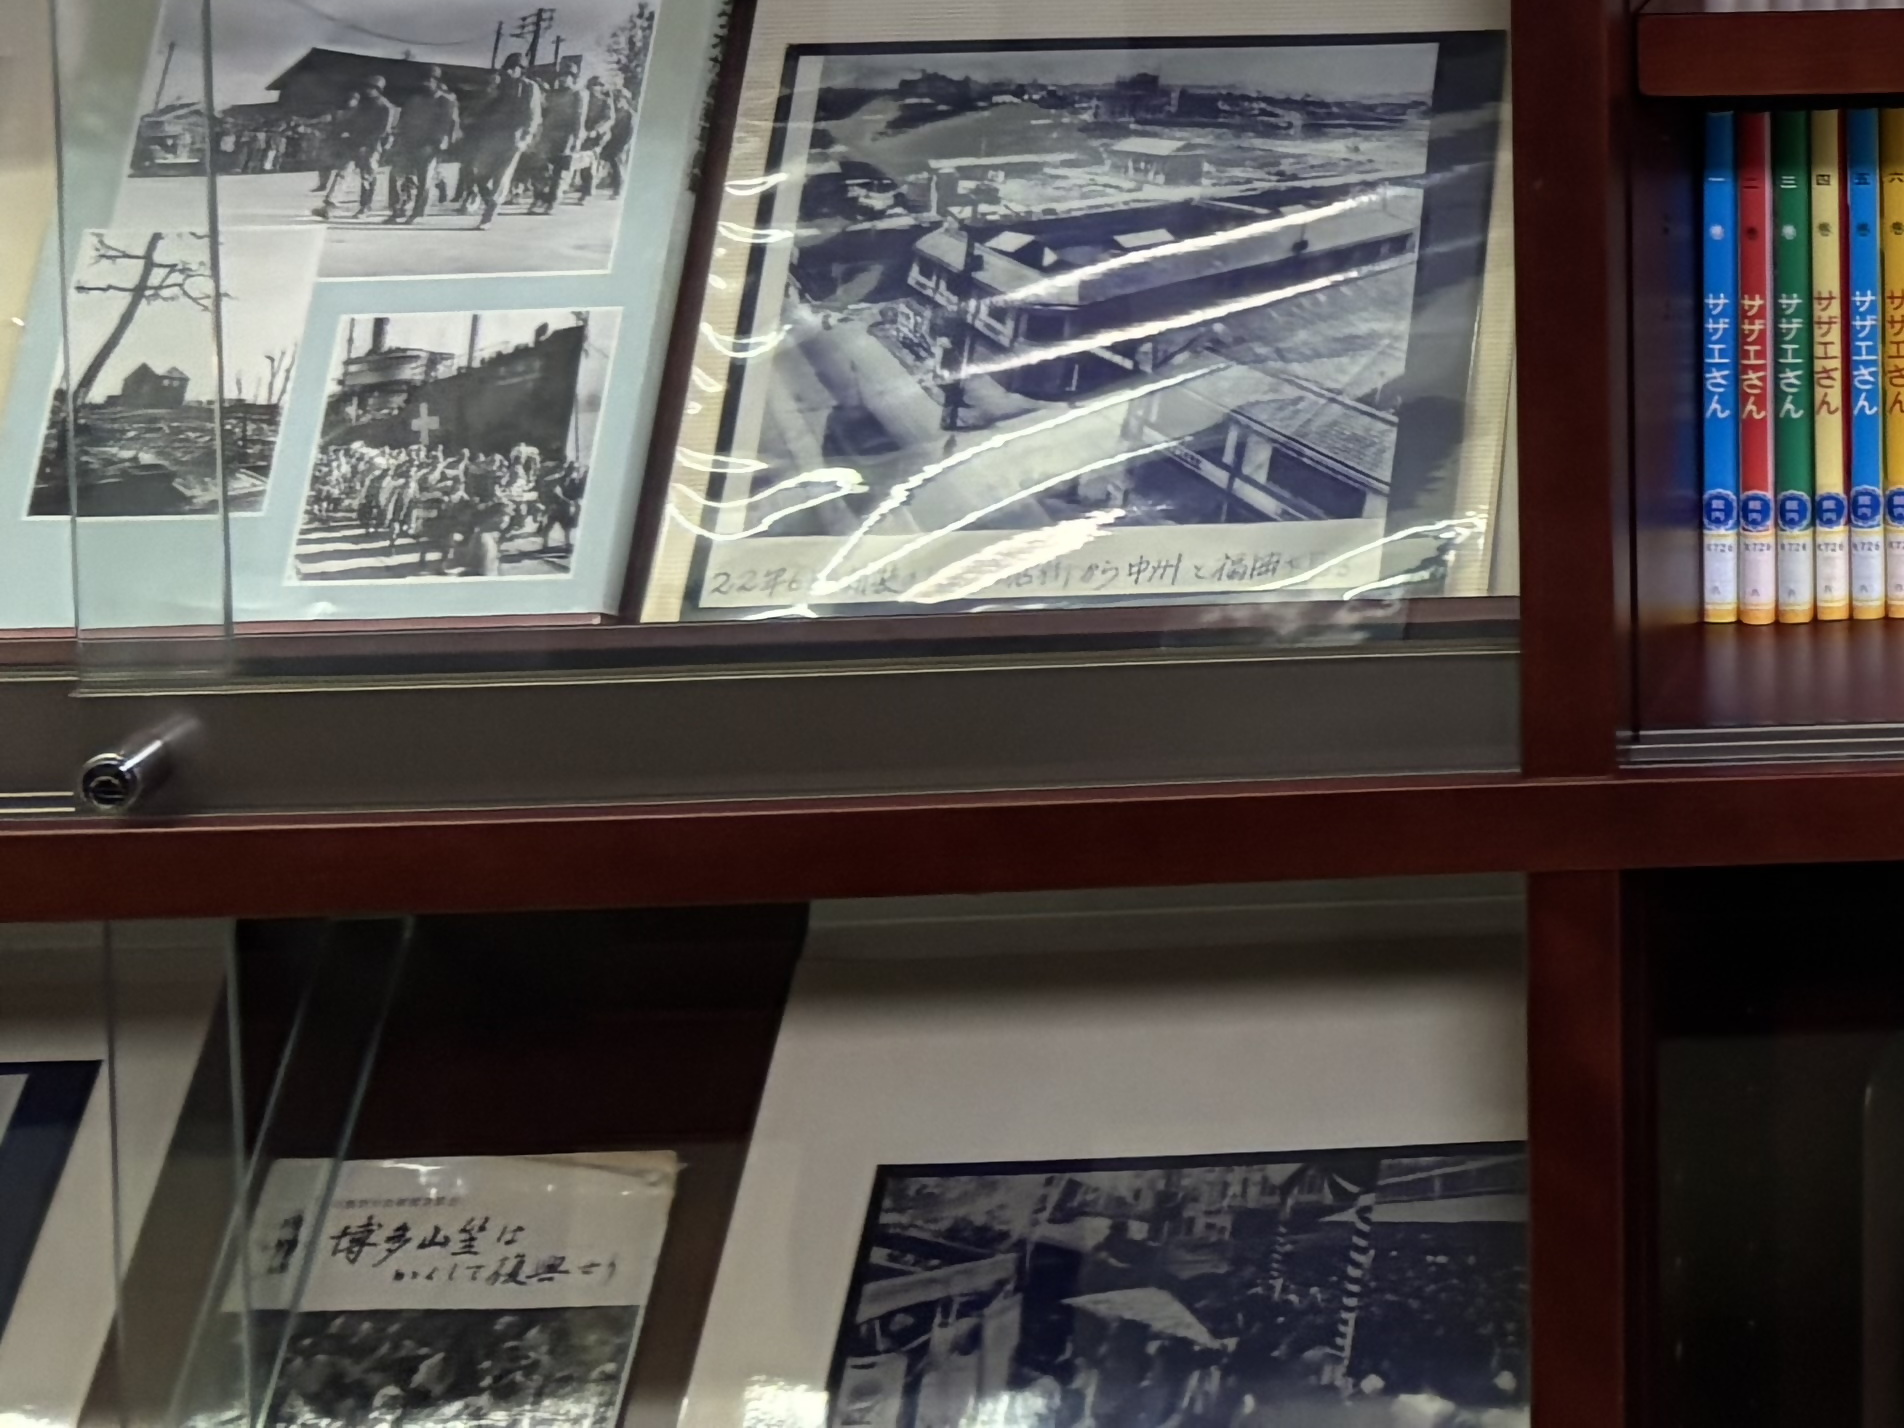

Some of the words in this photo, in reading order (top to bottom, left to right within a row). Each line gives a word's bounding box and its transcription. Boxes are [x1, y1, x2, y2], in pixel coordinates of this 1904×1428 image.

[1705, 293, 1730, 419] サザエさん
[1741, 294, 1767, 420] サザエさん
